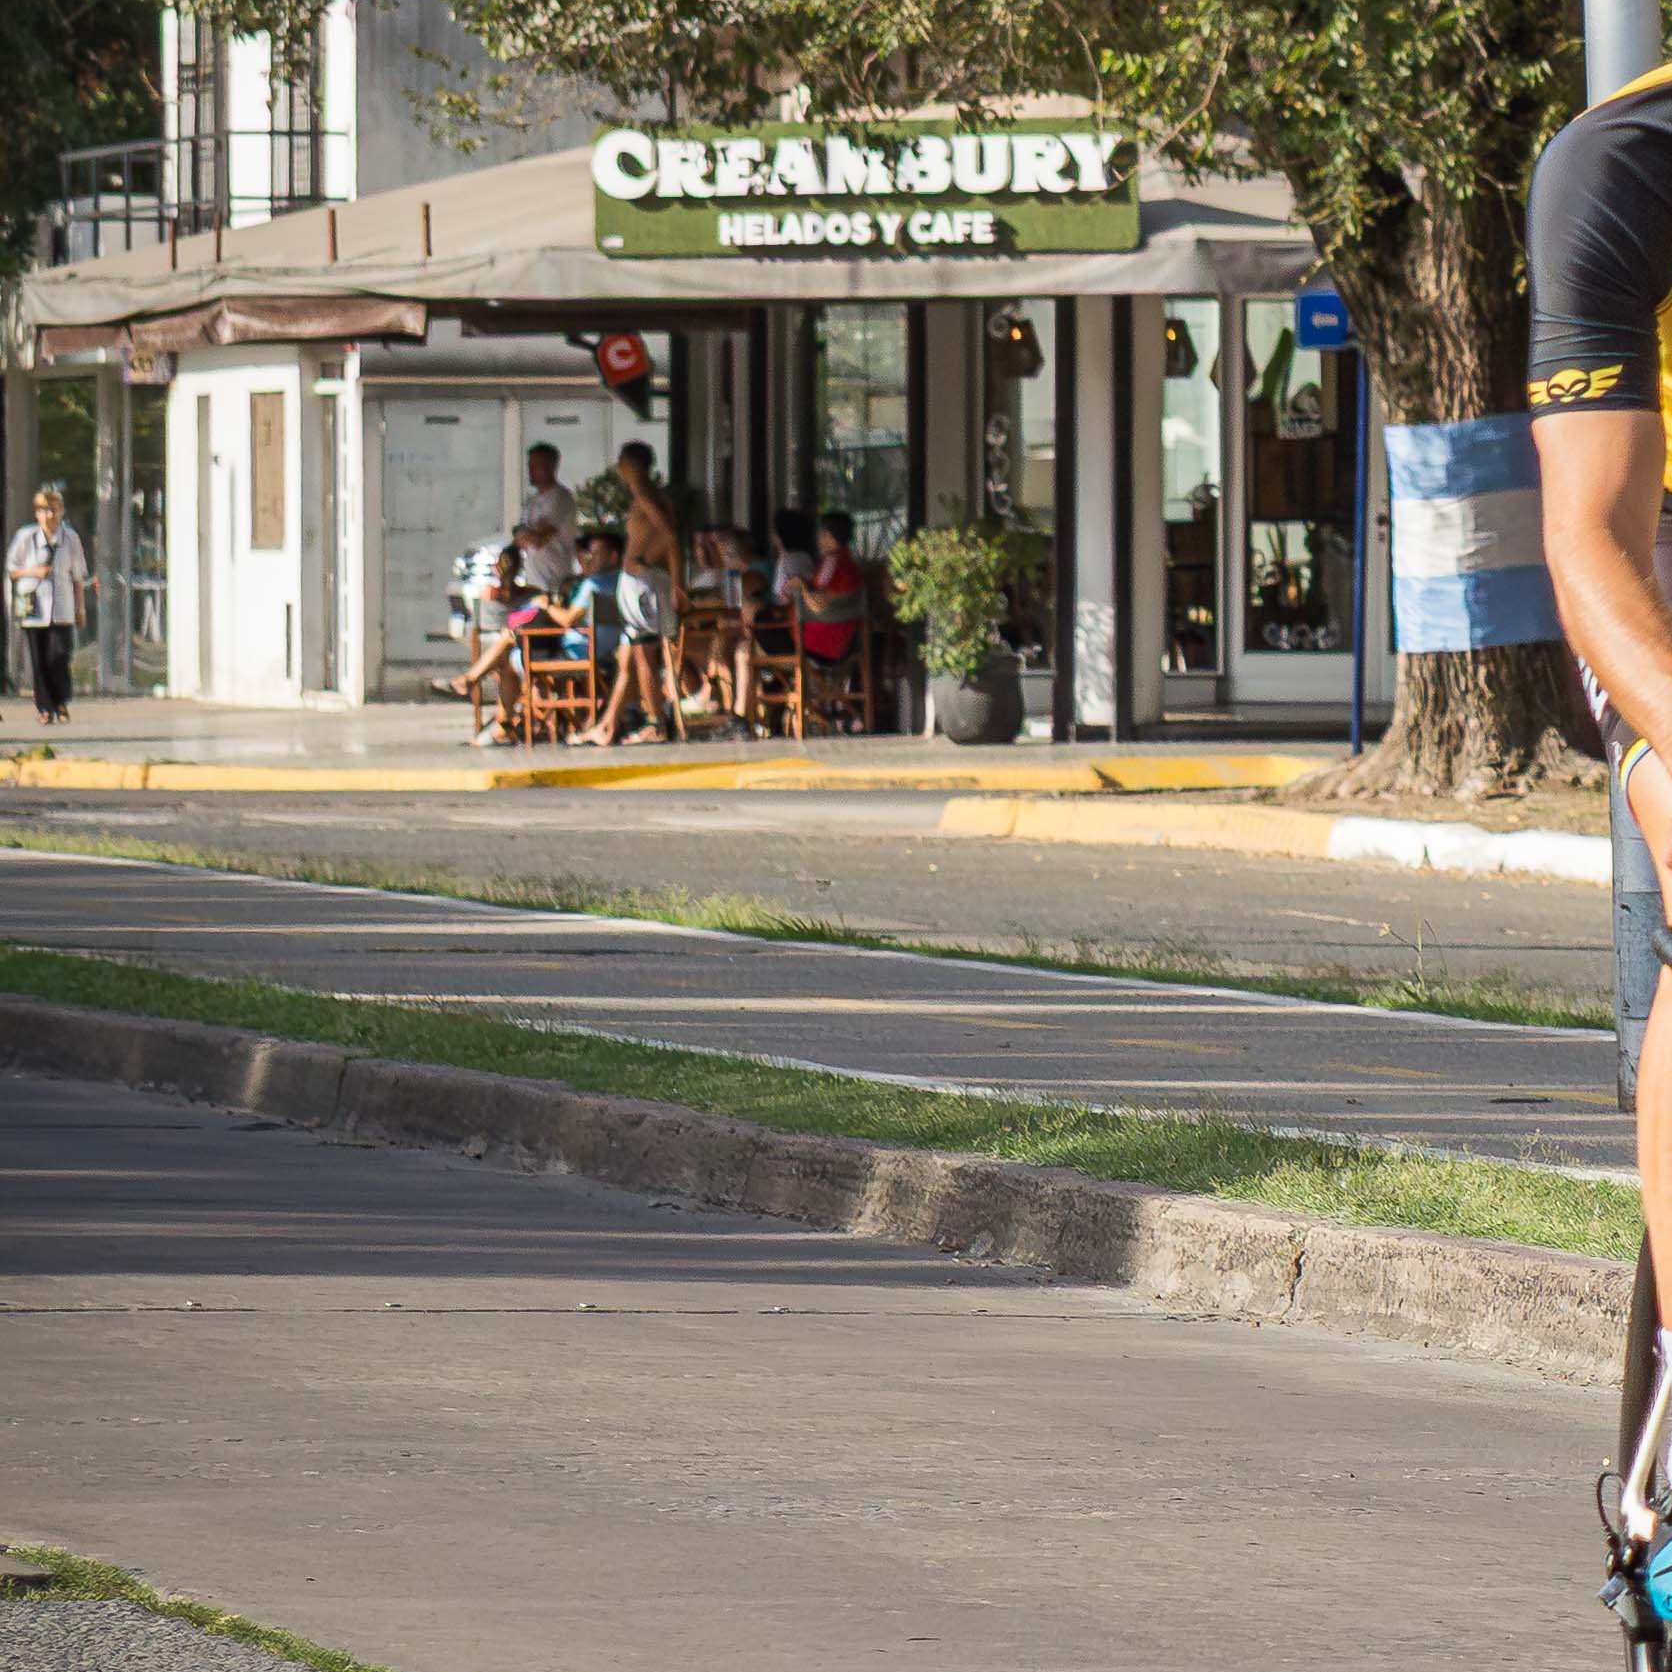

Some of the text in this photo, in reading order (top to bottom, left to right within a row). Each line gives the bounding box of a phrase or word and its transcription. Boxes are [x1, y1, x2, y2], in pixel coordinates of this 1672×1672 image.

[592, 128, 1122, 200] CREAMBURY
[718, 210, 995, 246] HELADOS Y CAFE
